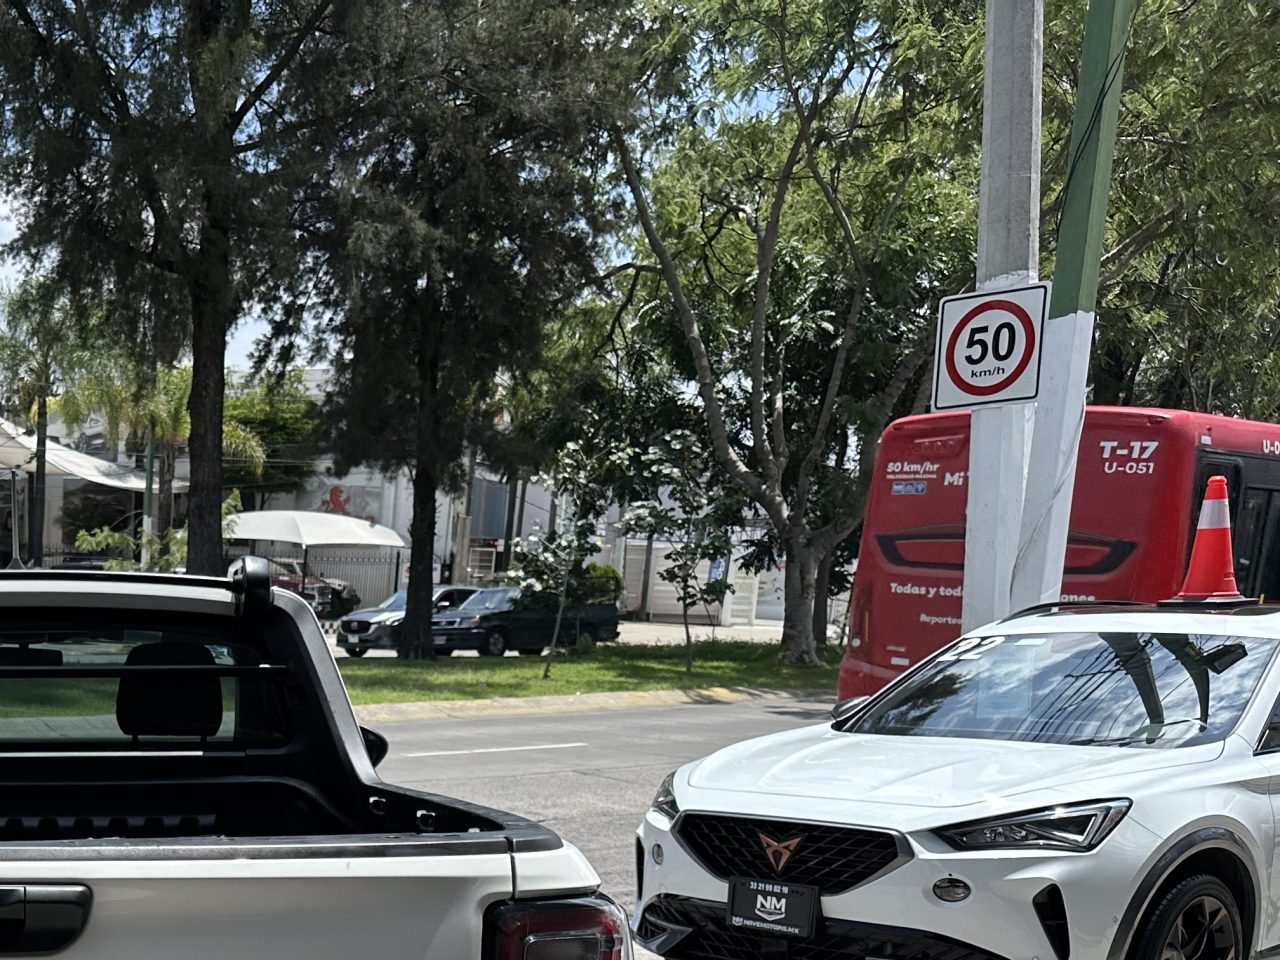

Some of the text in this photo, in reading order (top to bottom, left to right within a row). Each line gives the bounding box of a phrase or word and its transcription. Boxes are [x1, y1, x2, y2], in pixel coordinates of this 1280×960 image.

[964, 321, 1016, 366] 50
[970, 366, 1006, 379] km/h
[1099, 441, 1159, 459] T-17
[1262, 439, 1280, 454] U-0
[886, 461, 940, 474] 50 km/hr
[1104, 462, 1155, 474] U-051
[943, 472, 965, 486] Mi
[889, 582, 926, 595] Todas
[927, 587, 937, 598] y
[939, 586, 963, 597] tod
[936, 636, 1006, 662] 22
[756, 894, 787, 913] NM
